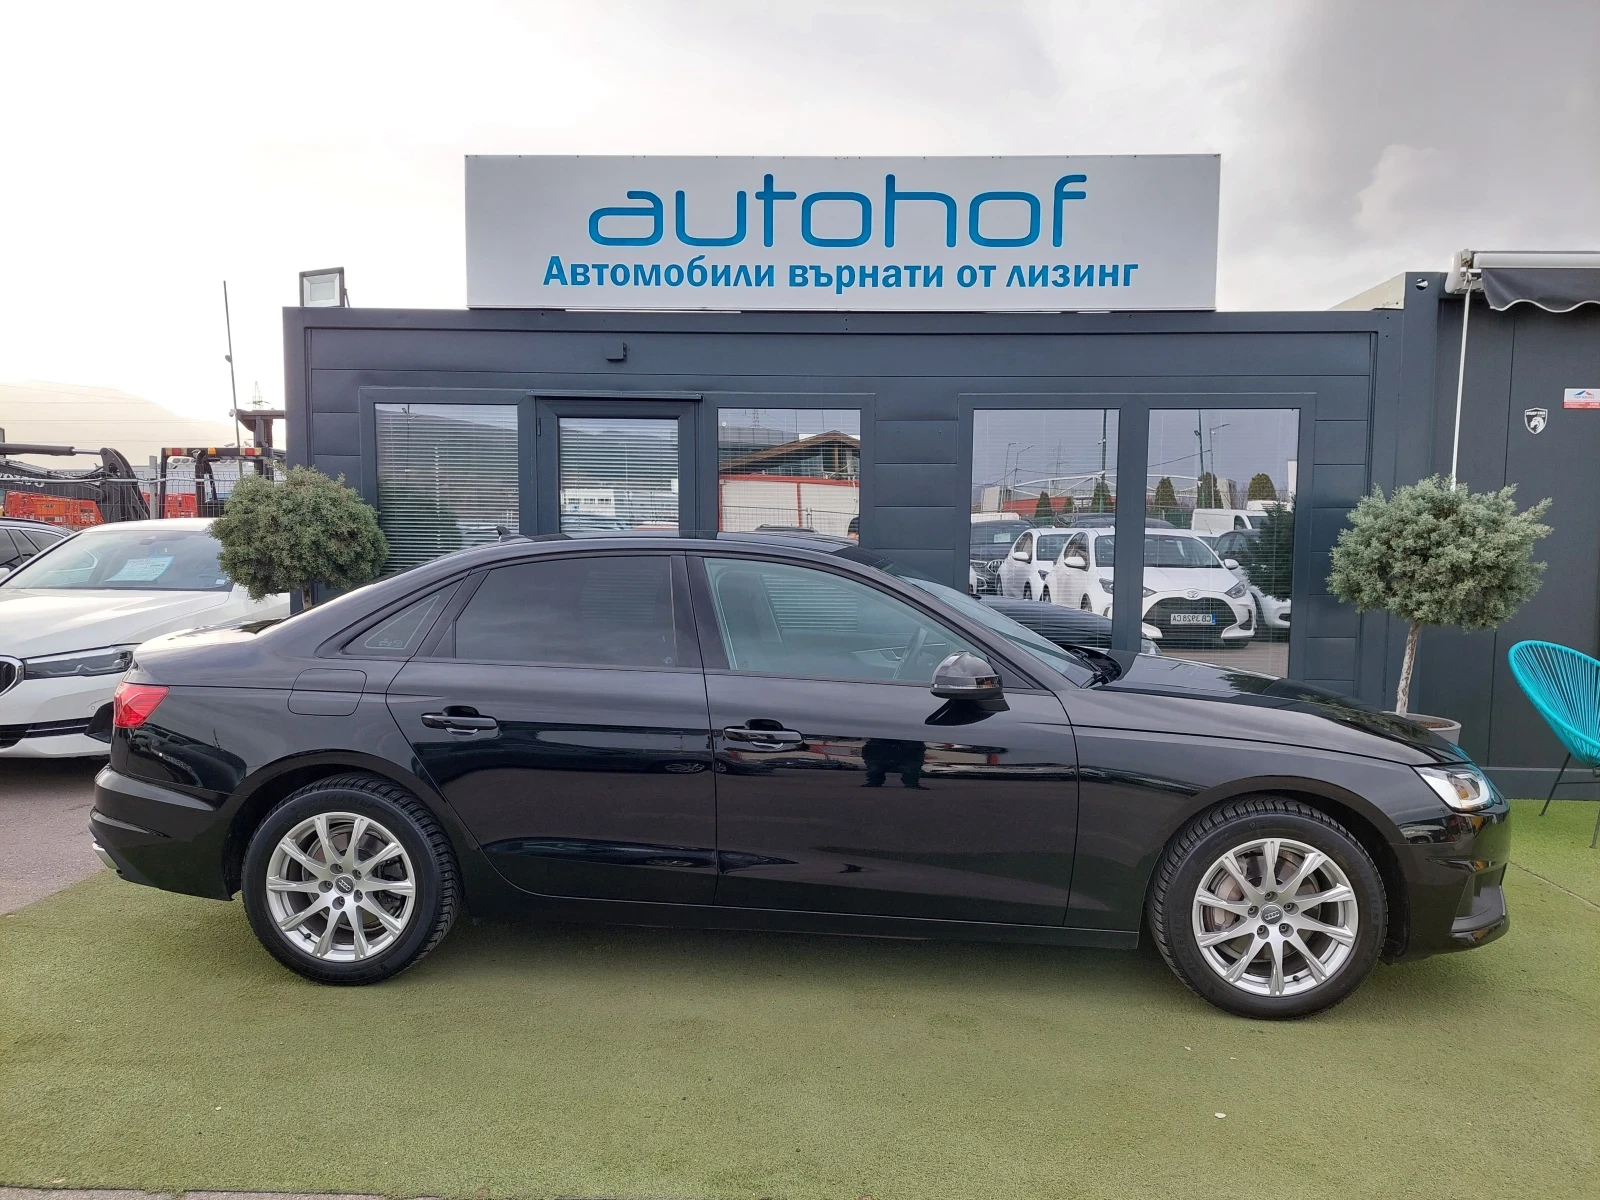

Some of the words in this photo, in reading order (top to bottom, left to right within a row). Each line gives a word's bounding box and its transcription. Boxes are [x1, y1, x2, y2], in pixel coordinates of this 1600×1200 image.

[587, 173, 1088, 248] autohof
[542, 254, 776, 288] Автомобили
[788, 264, 944, 295] върнати
[956, 264, 997, 289] от
[1006, 263, 1139, 289] лизинг
